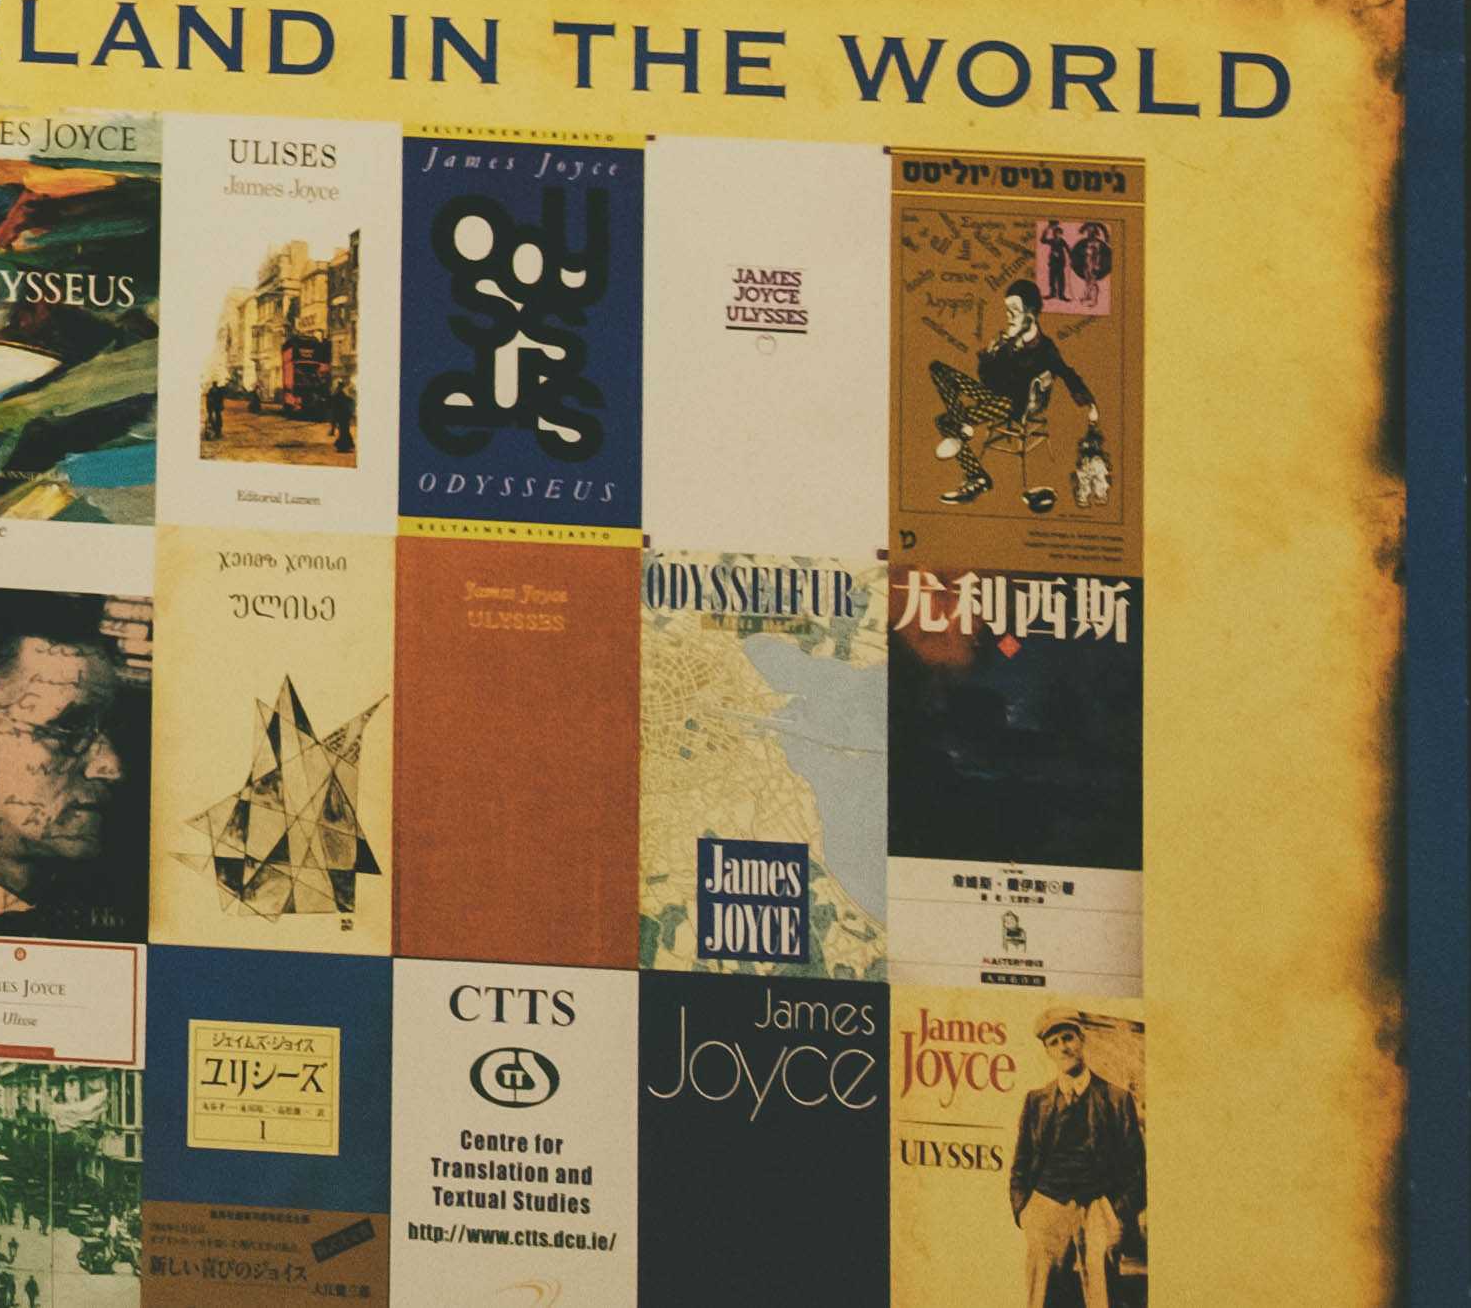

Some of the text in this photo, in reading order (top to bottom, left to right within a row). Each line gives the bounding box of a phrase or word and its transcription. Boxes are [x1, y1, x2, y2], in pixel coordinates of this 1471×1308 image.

[389, 13, 500, 86] IN
[552, 21, 787, 100] THE
[837, 34, 1293, 120] WORLD
[40, 116, 138, 153] JOYCE
[227, 137, 339, 170] ULISES
[422, 145, 620, 182] James Joyce
[222, 174, 340, 205] James Joyce
[730, 267, 803, 288] JAMES
[732, 286, 802, 306] JOYCE
[725, 305, 809, 327] ULYSSES
[236, 488, 283, 507] Editorial
[418, 471, 616, 503] ODYSSEUS
[467, 610, 566, 632] ULYSSES
[890, 569, 1132, 644] 尤利西斯
[704, 844, 801, 897] James
[704, 903, 801, 957] JOYCE
[23, 977, 67, 998] JOYCE
[1, 1010, 38, 1028] Ulisse
[448, 983, 577, 1028] CTTS
[754, 987, 876, 1036] James
[918, 1006, 1008, 1048] James
[200, 1057, 329, 1097] ユリシーズ
[647, 1004, 878, 1122] Joyce
[898, 1029, 1018, 1109] Joyce
[460, 1129, 564, 1156] Centre for
[898, 1137, 1004, 1173] ULYSSES
[430, 1156, 594, 1187] Translation and
[432, 1186, 592, 1215] Textual Studies
[407, 1222, 617, 1253] http://www.ctts.dcu.ie/
